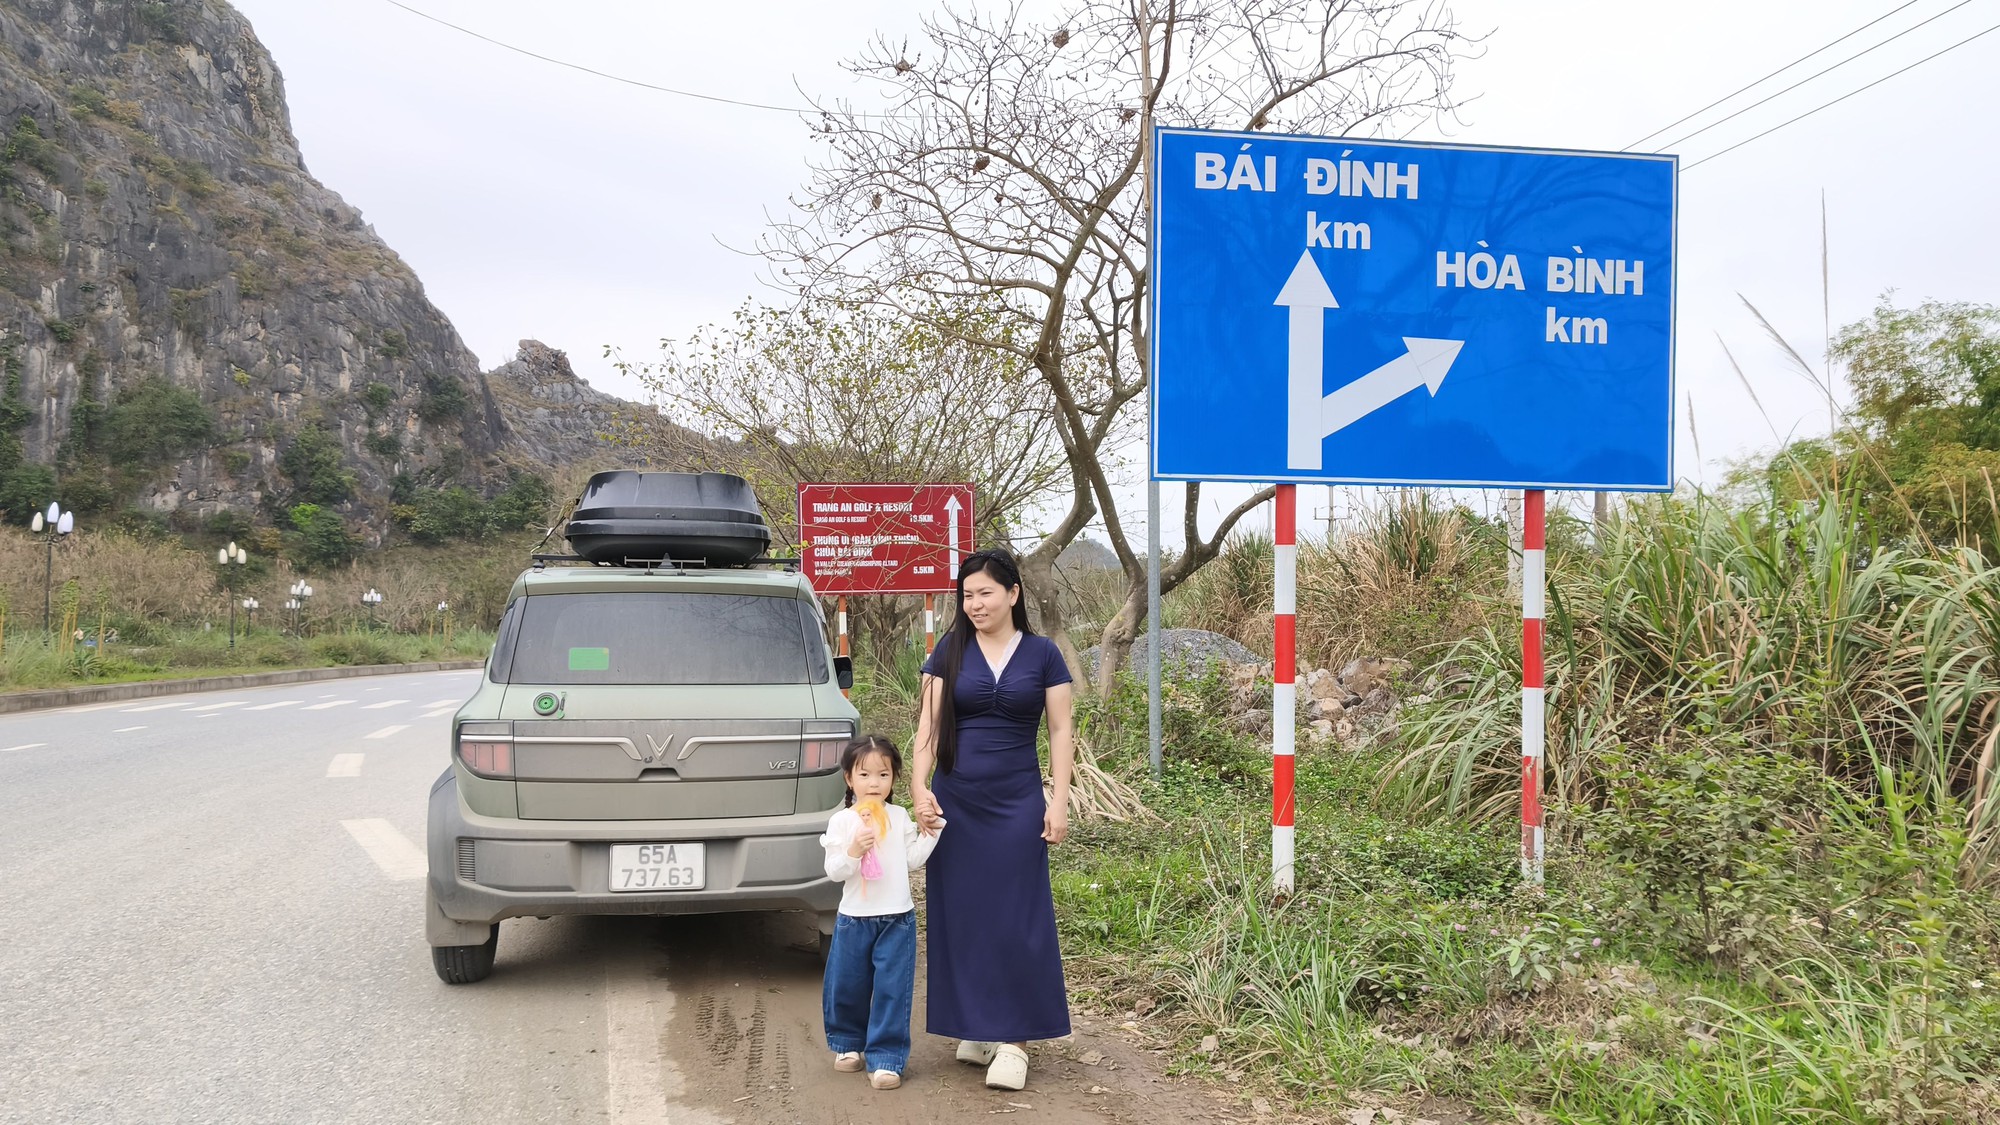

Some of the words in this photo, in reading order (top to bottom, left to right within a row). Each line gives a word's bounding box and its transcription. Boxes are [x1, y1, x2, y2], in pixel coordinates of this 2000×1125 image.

[1195, 143, 1277, 192] BÁI
[1303, 149, 1419, 200] ĐÍNH
[1306, 210, 1372, 250] km
[1436, 240, 1526, 291] HÒA
[1546, 245, 1644, 296] BÌNH
[1545, 306, 1608, 345] km
[813, 502, 839, 512] TRANG
[840, 502, 852, 512] AN
[854, 502, 873, 512] GOLF
[913, 566, 934, 574] 5.5KM
[639, 845, 677, 865] 65A
[621, 867, 694, 887] 737.63
